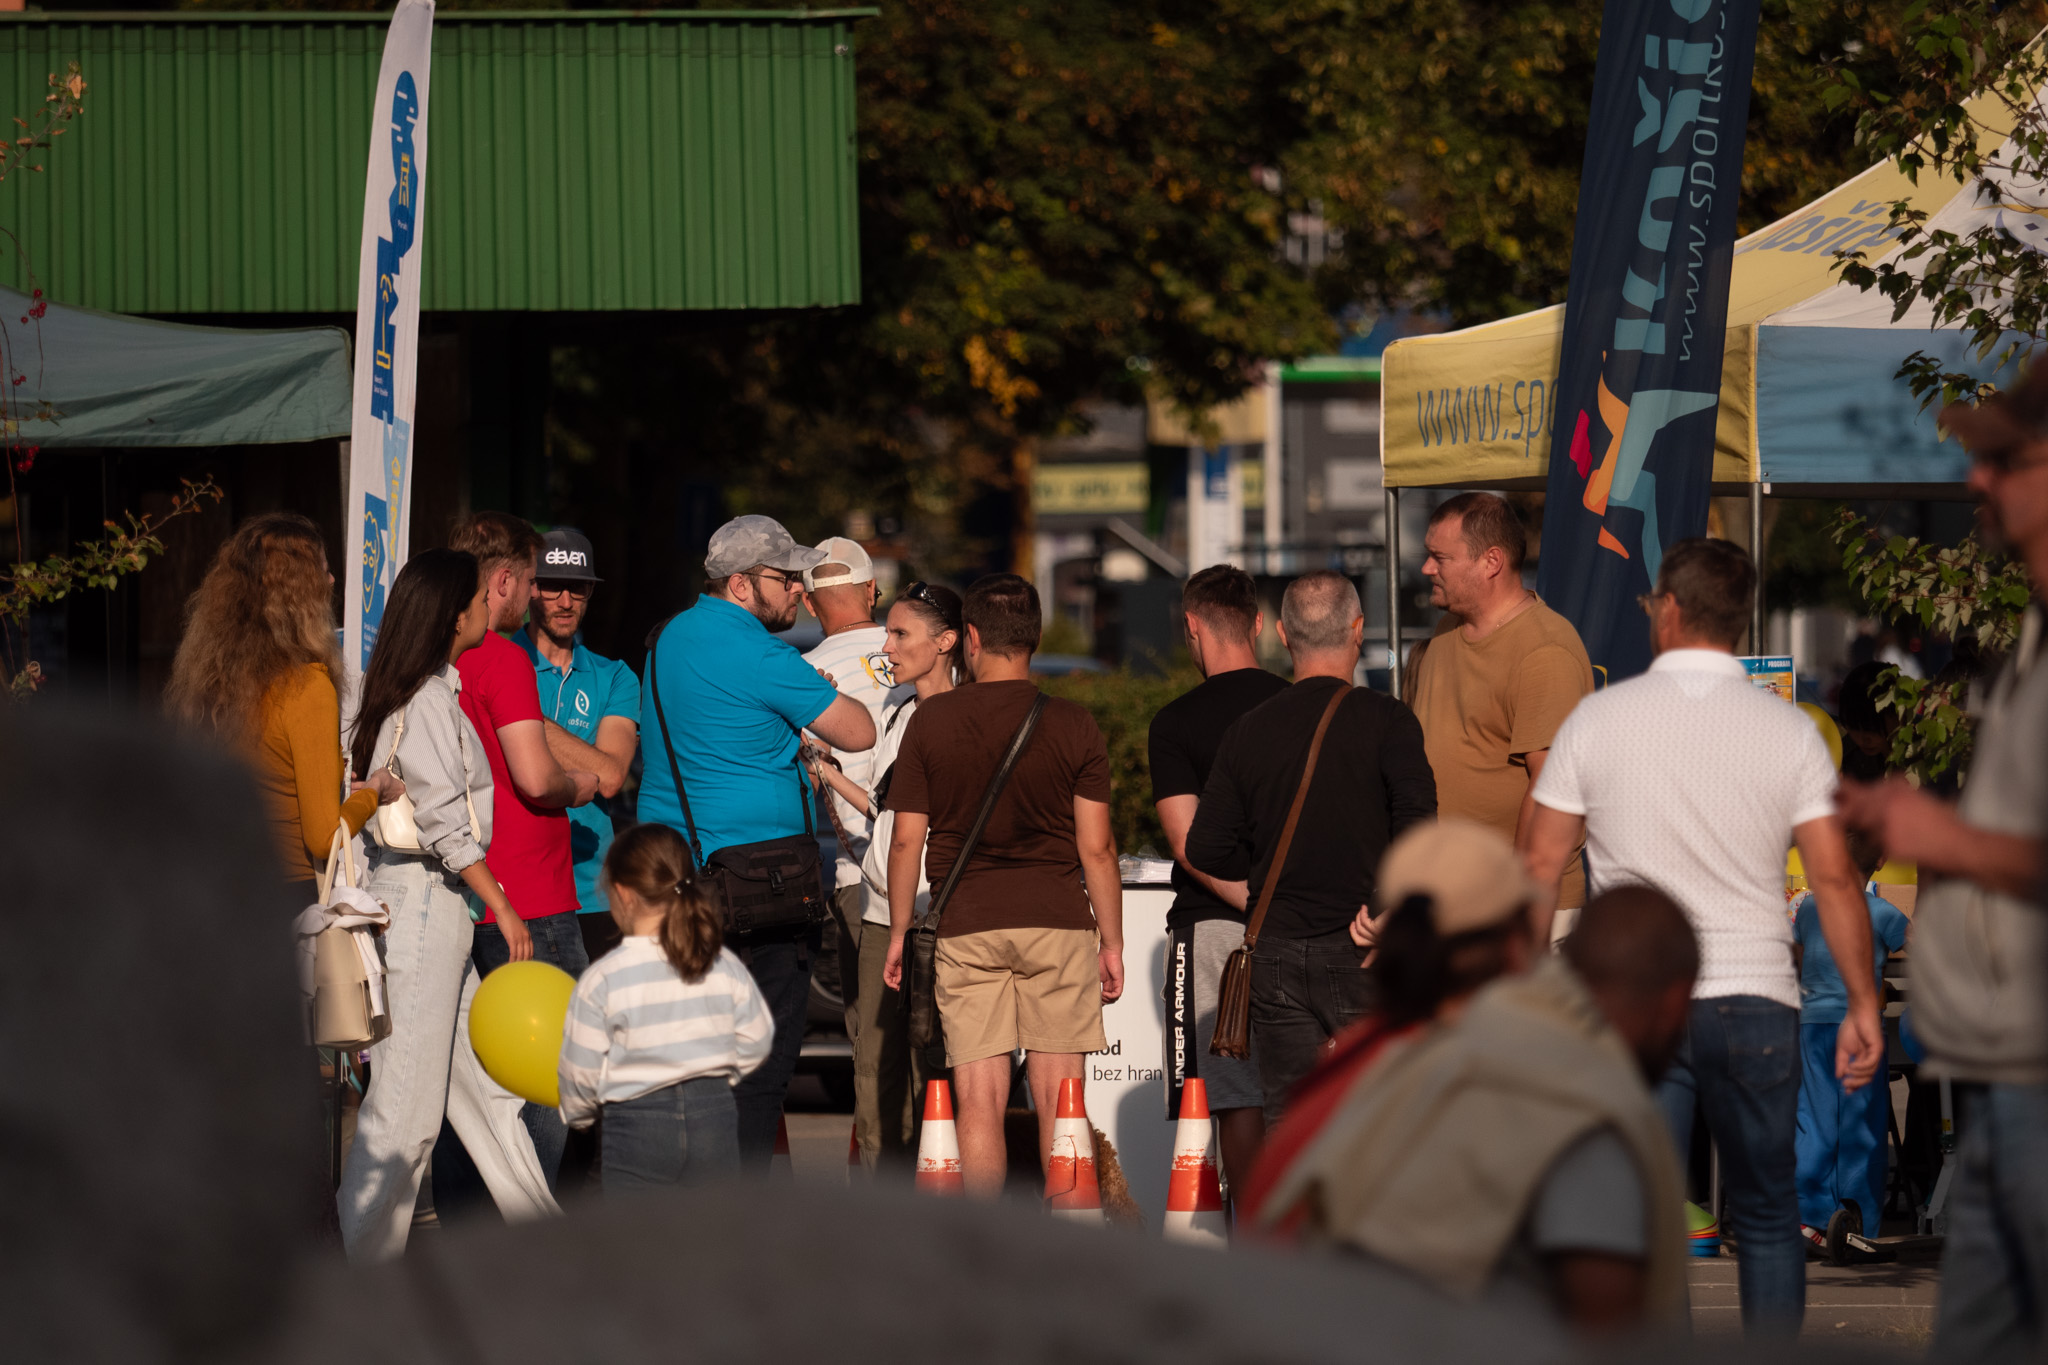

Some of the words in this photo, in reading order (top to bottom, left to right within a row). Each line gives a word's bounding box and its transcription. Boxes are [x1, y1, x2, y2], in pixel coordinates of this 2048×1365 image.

[545, 547, 588, 568] eleven
[1174, 942, 1186, 1023] ARMOUR
[1093, 1064, 1122, 1081] bez
[1174, 1026, 1186, 1088] UNDER
